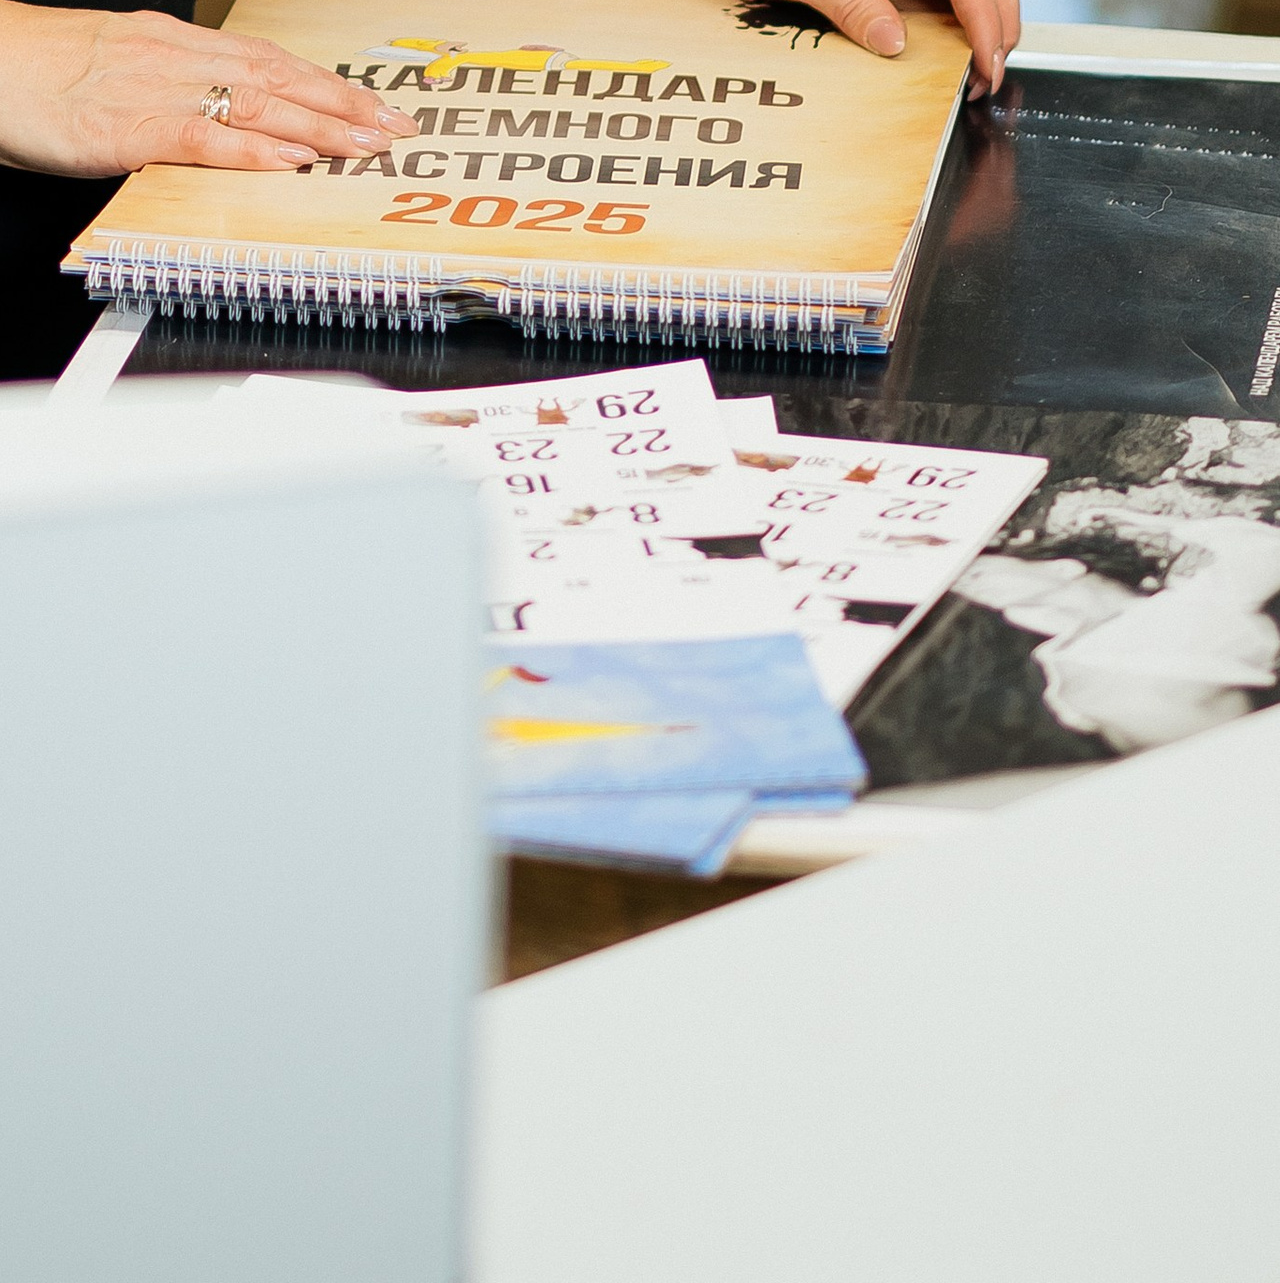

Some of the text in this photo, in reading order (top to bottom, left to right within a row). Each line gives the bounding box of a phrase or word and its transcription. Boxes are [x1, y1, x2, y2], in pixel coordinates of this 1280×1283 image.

[336, 63, 804, 108] КАЛЕНДАРЬ
[380, 191, 650, 235] 2025
[1250, 378, 1274, 396] НАД
[596, 389, 660, 420] 29
[496, 428, 671, 462] 22 23
[505, 473, 555, 495] 16
[907, 465, 978, 490] 29
[629, 502, 661, 524] 8
[768, 488, 950, 521] 22 23
[524, 538, 556, 560] 2
[821, 562, 858, 582] 8
